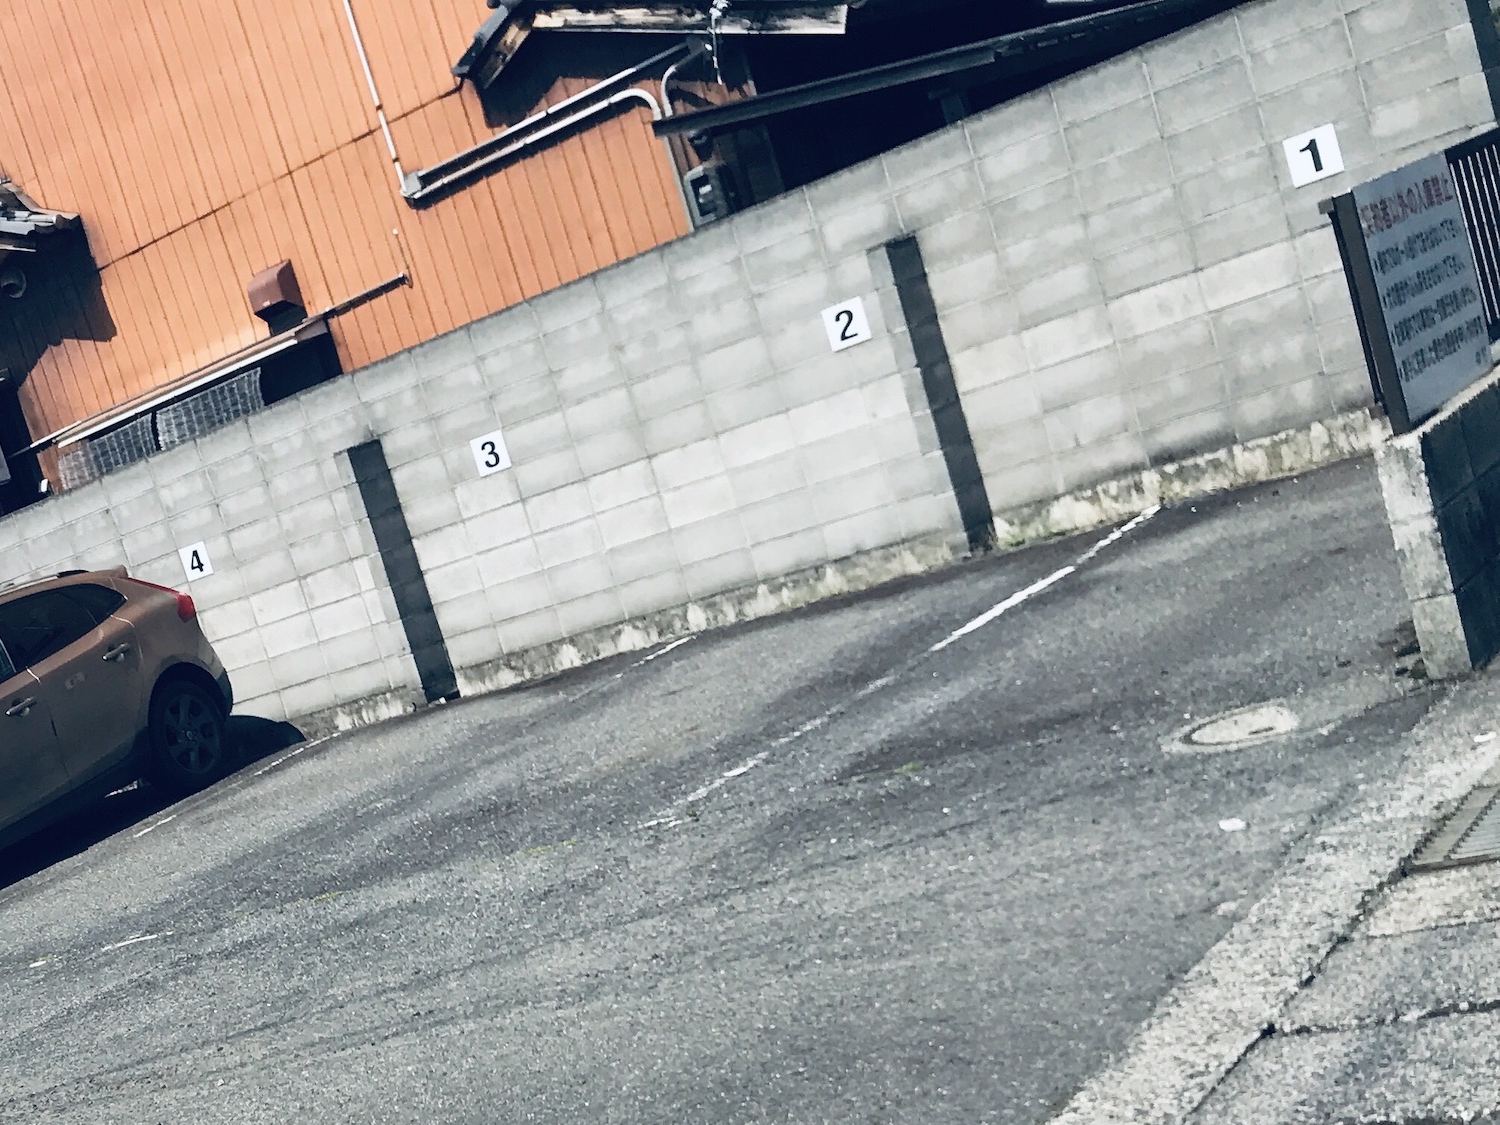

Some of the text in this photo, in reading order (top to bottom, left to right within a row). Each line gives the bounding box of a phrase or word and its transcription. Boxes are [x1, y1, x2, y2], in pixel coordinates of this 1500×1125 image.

[1299, 138, 1323, 172] 1
[835, 310, 858, 341] 2
[481, 441, 500, 468] 3
[191, 549, 204, 572] 4
